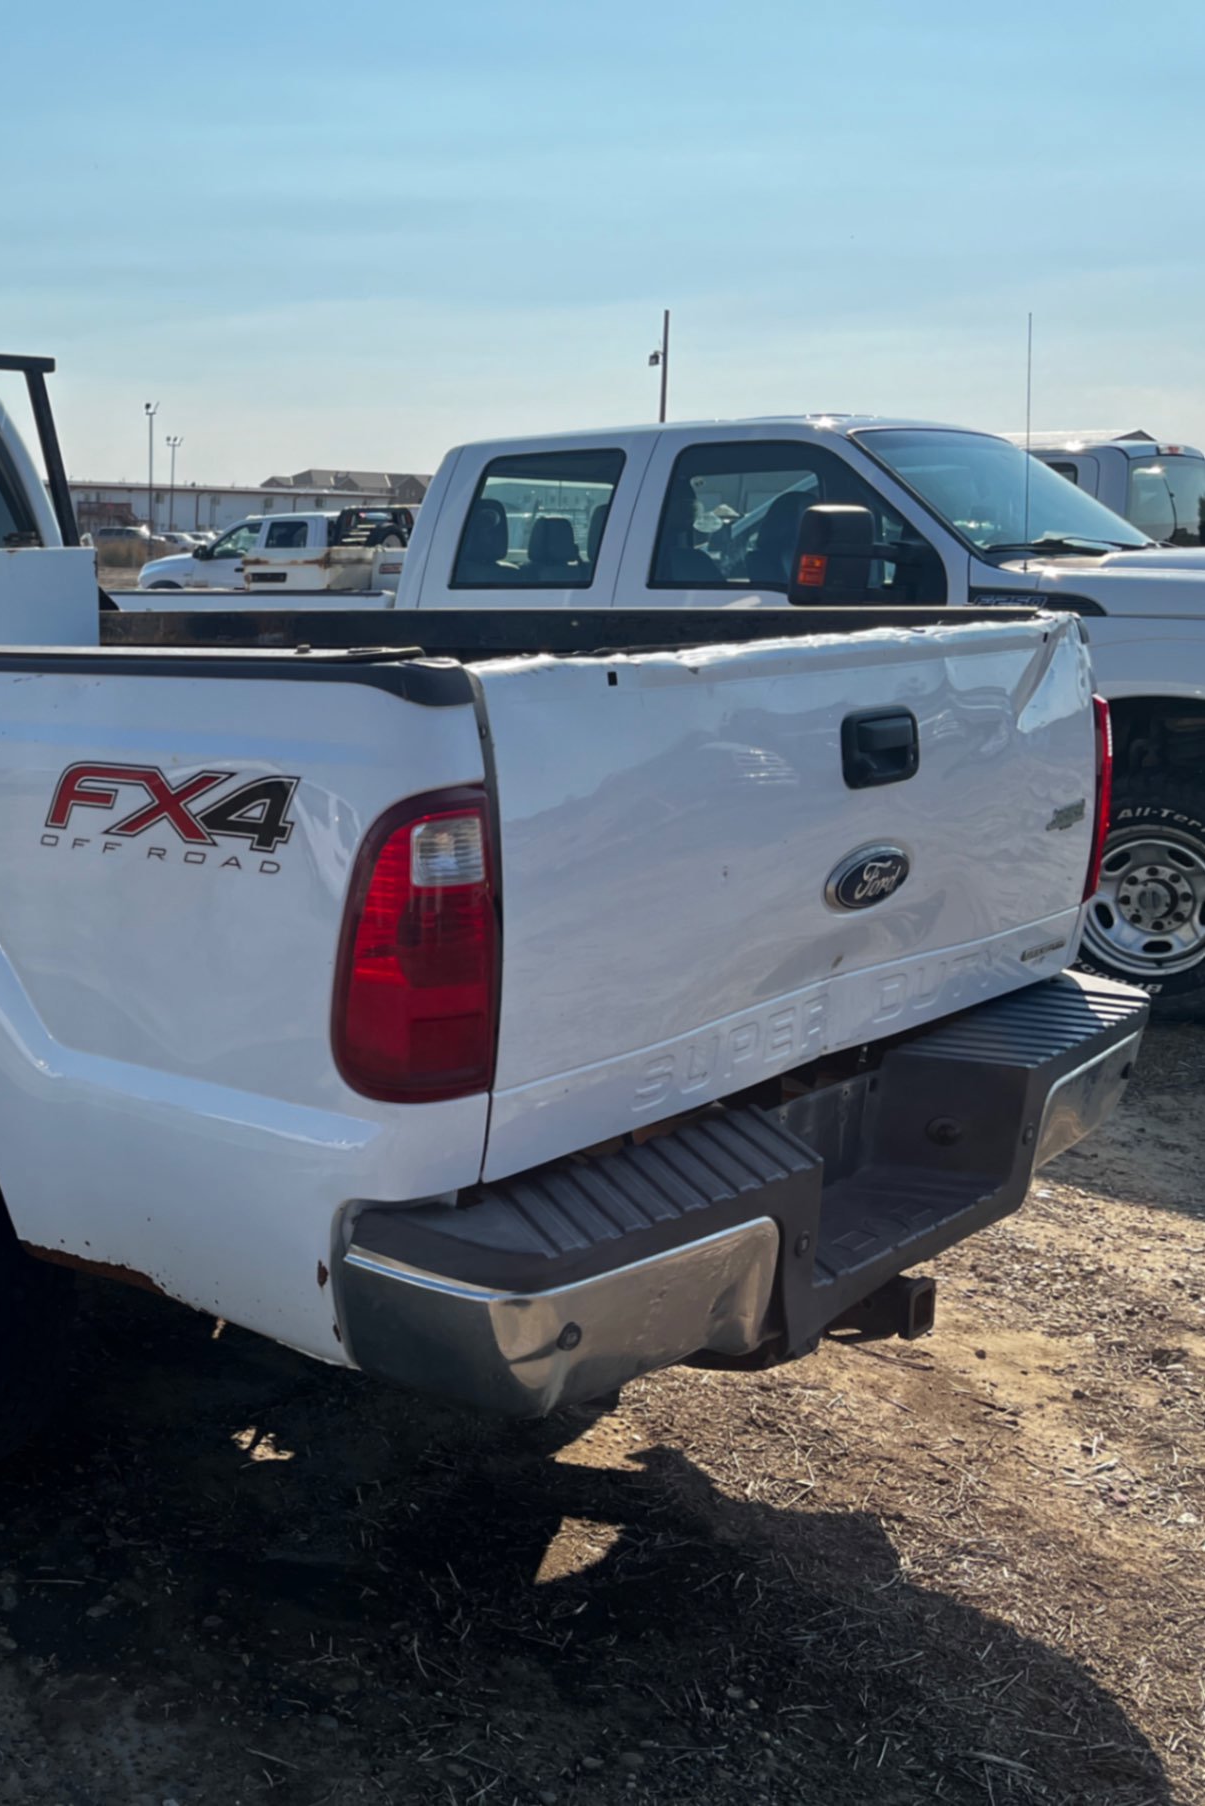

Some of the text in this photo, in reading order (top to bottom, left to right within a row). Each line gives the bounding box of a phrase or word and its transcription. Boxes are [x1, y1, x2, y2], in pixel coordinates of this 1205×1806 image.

[45, 761, 301, 853] FX4
[40, 834, 281, 874] OFF ROAD
[853, 860, 902, 901] Ford
[630, 994, 830, 1112] SUPER
